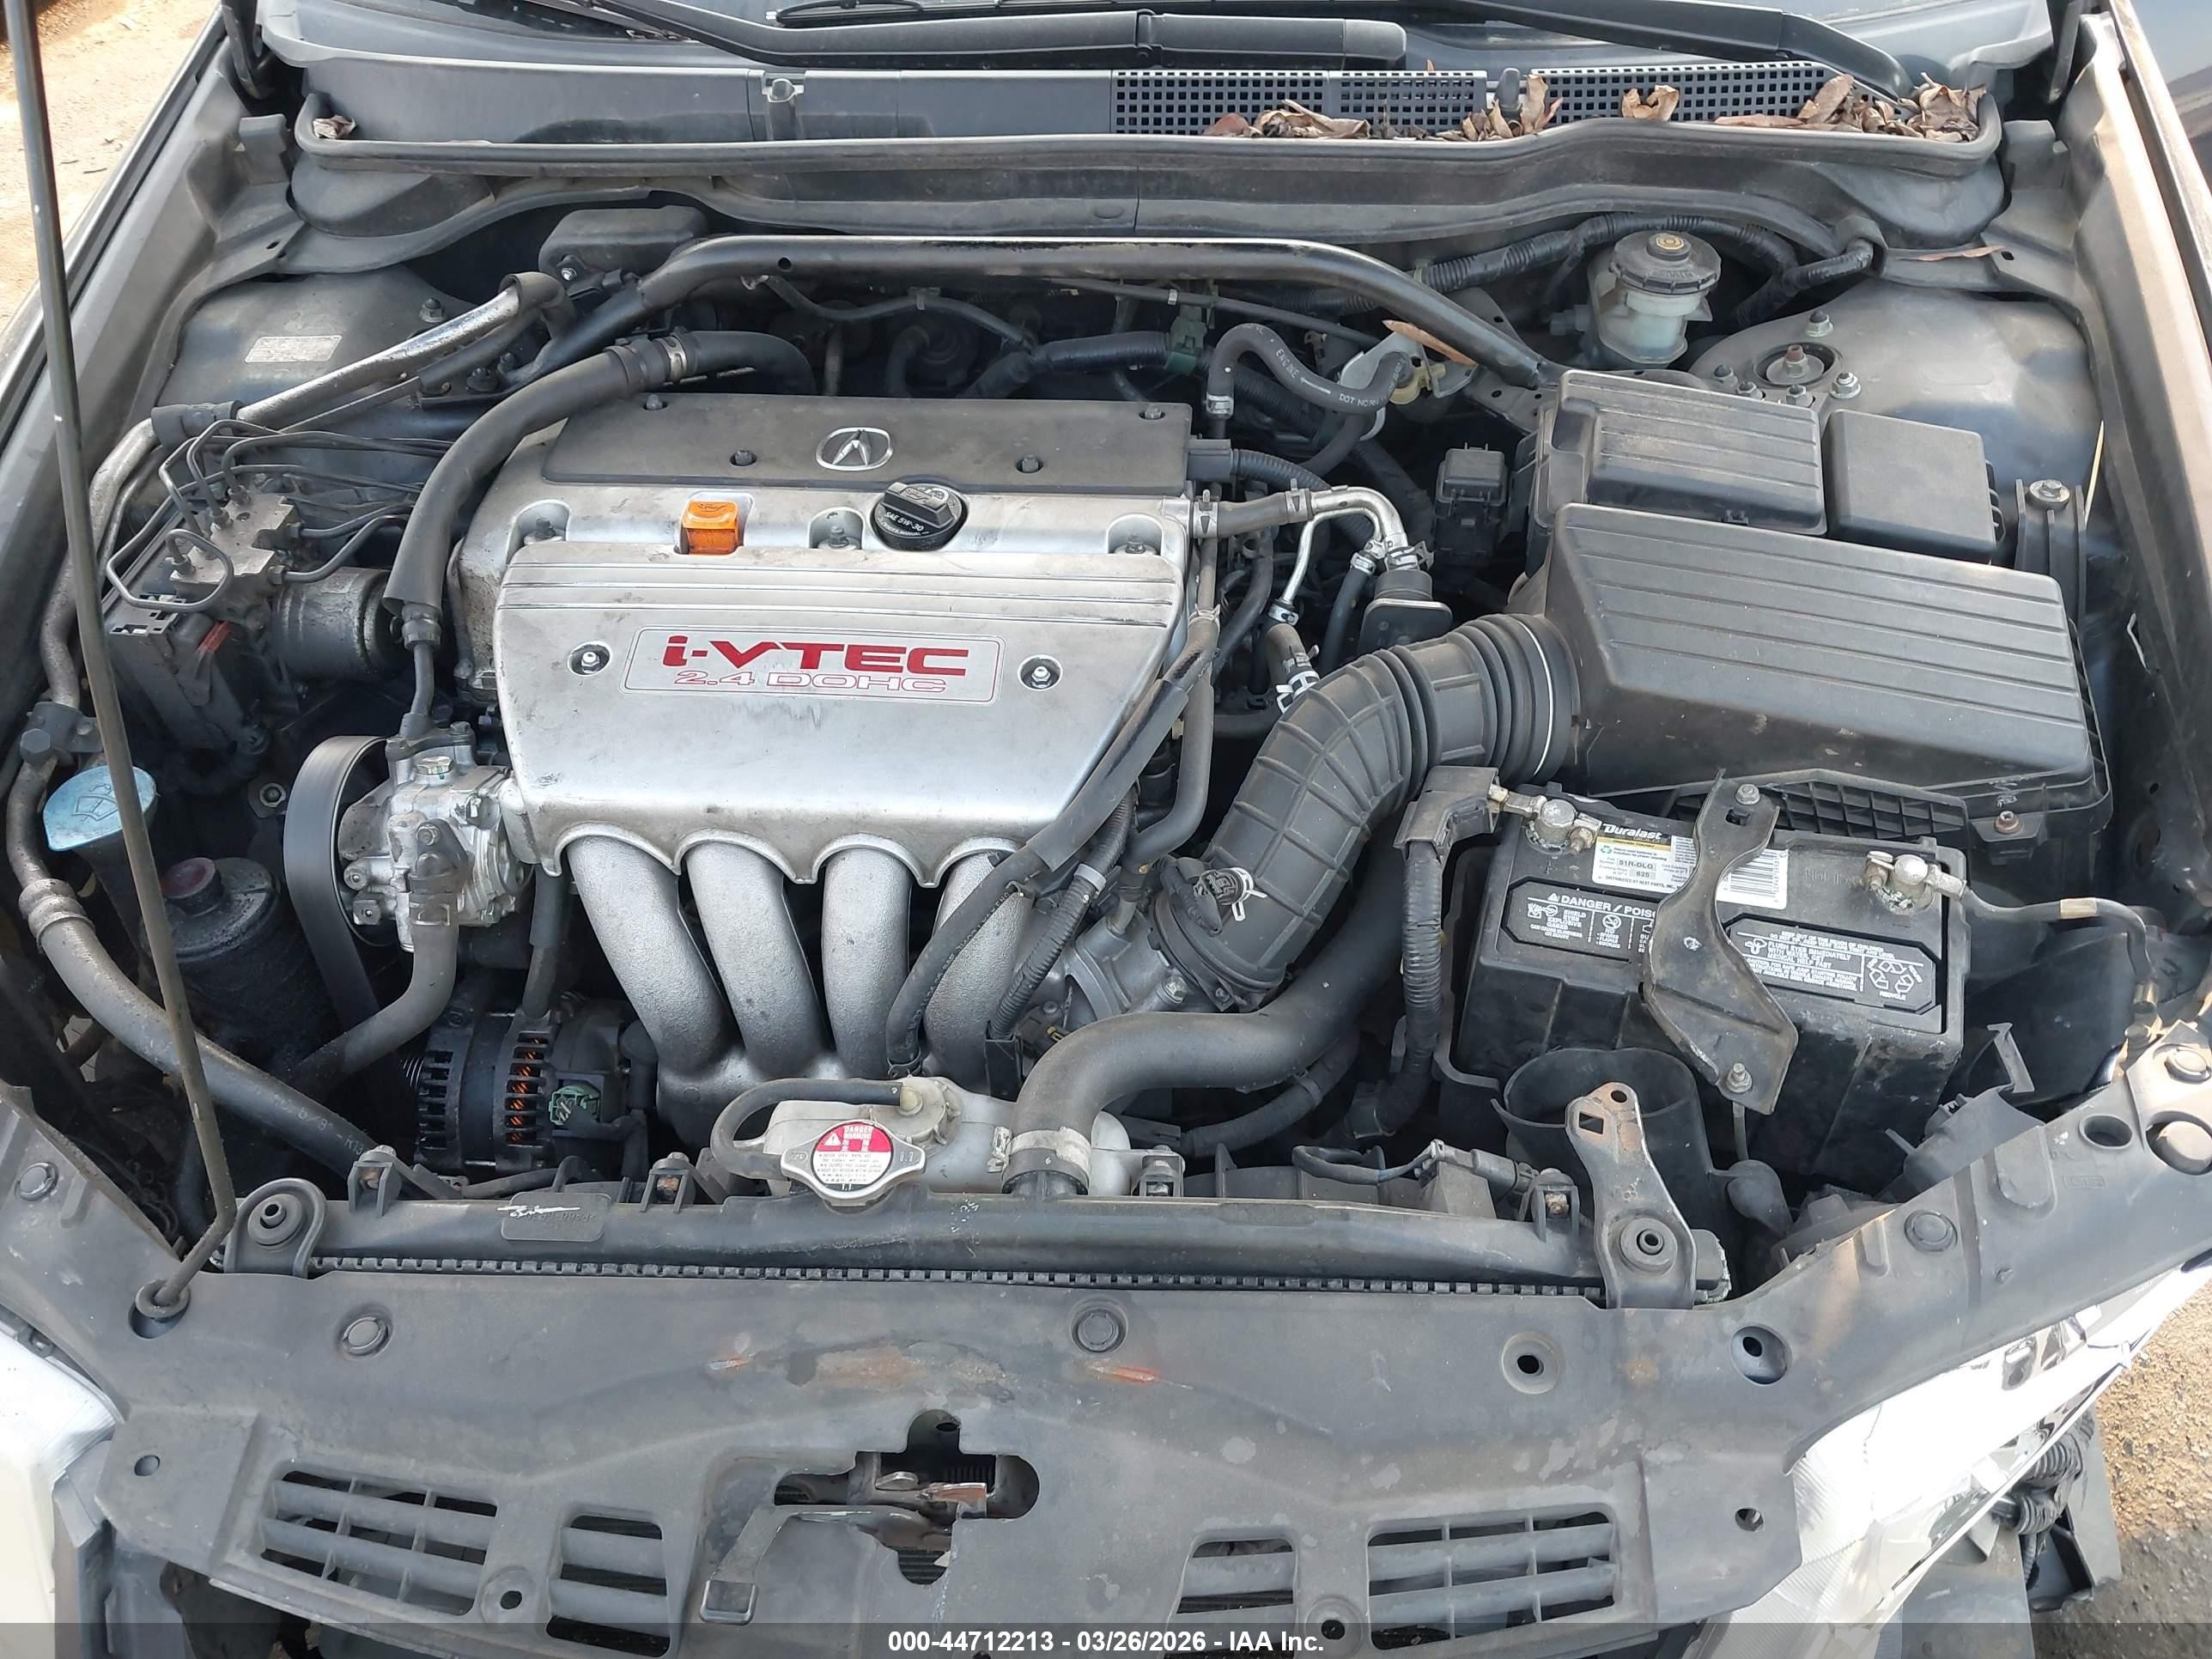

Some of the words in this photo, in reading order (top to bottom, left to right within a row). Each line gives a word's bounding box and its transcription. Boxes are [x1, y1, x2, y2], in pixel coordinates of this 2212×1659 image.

[1275, 349, 1300, 379] ENGINE
[1339, 393, 1355, 405] DOT
[884, 512, 899, 521] SAE
[897, 517, 925, 532] 5W-30
[663, 635, 969, 677] i-VTEC
[674, 671, 755, 685] 2.4
[767, 672, 946, 693] DOHC
[1602, 823, 1662, 840] Duralast
[1560, 895, 1612, 911] DANGER
[1766, 952, 1796, 962] MEDICAL
[1767, 941, 1790, 950] FLUSH
[1808, 947, 1851, 961] IMMEDIATELY
